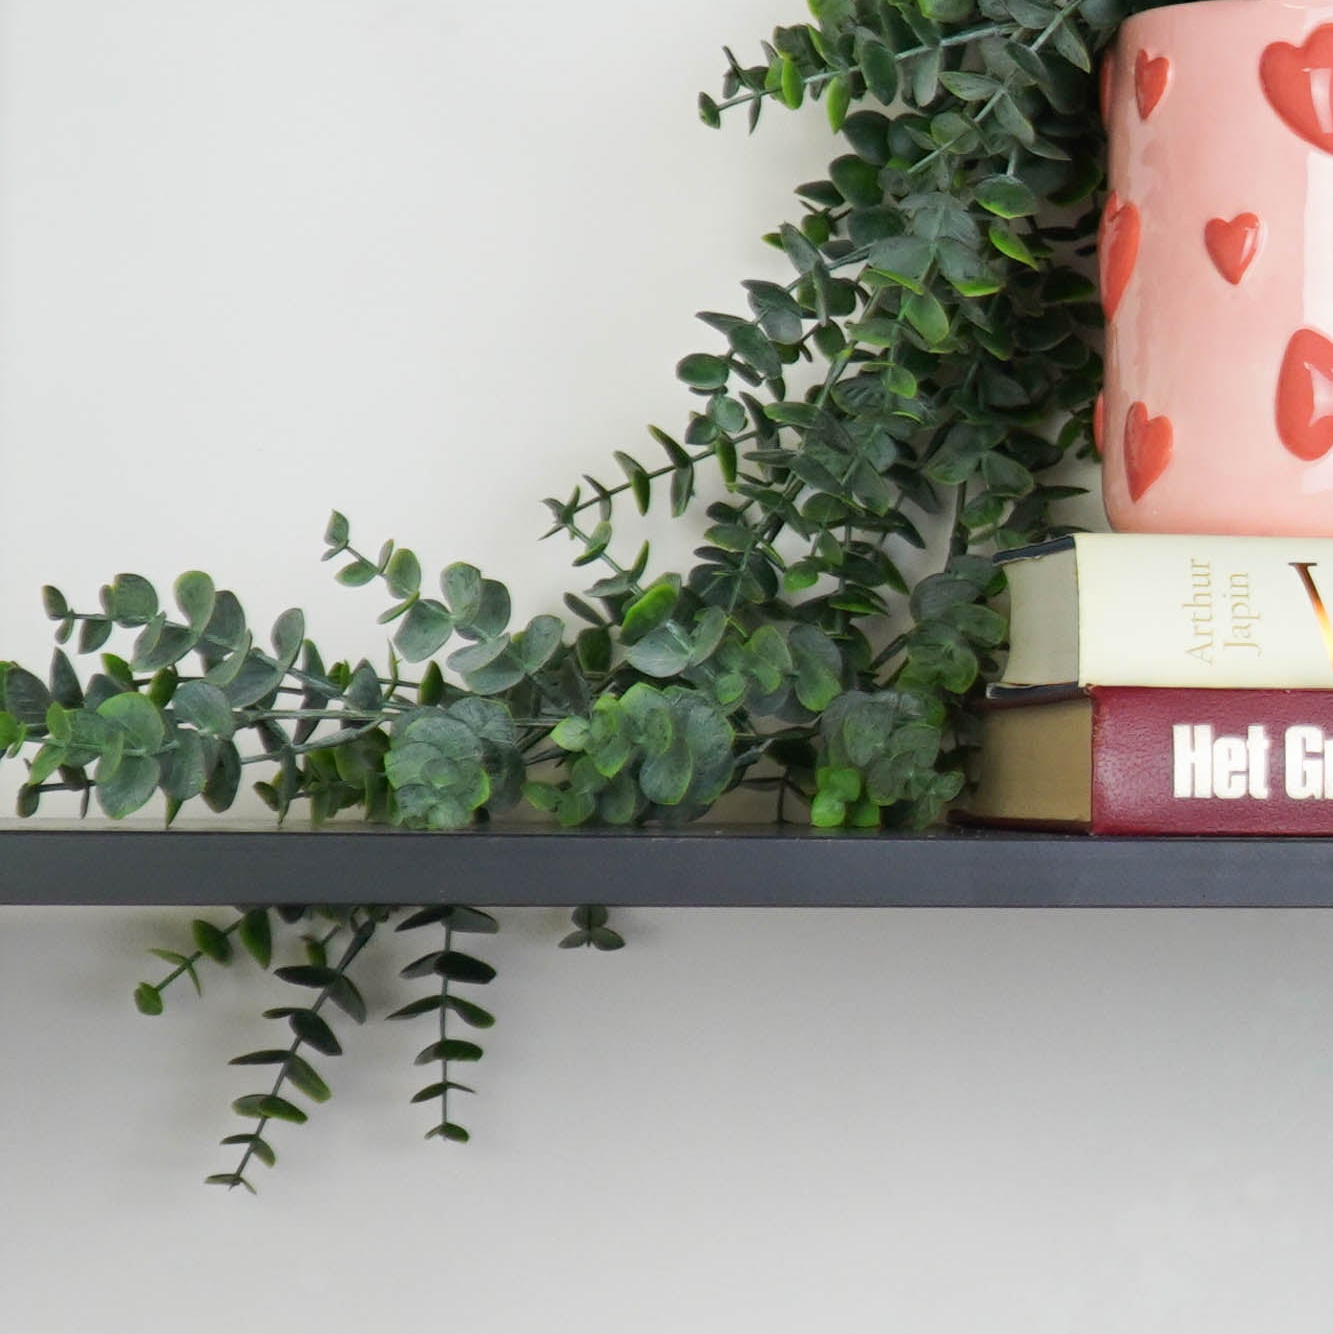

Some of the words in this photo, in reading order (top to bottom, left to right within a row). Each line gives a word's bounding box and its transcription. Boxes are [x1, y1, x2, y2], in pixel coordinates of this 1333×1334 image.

[1181, 557, 1213, 665] Arthur
[1223, 571, 1262, 657] Japin
[1171, 723, 1270, 800] Het
